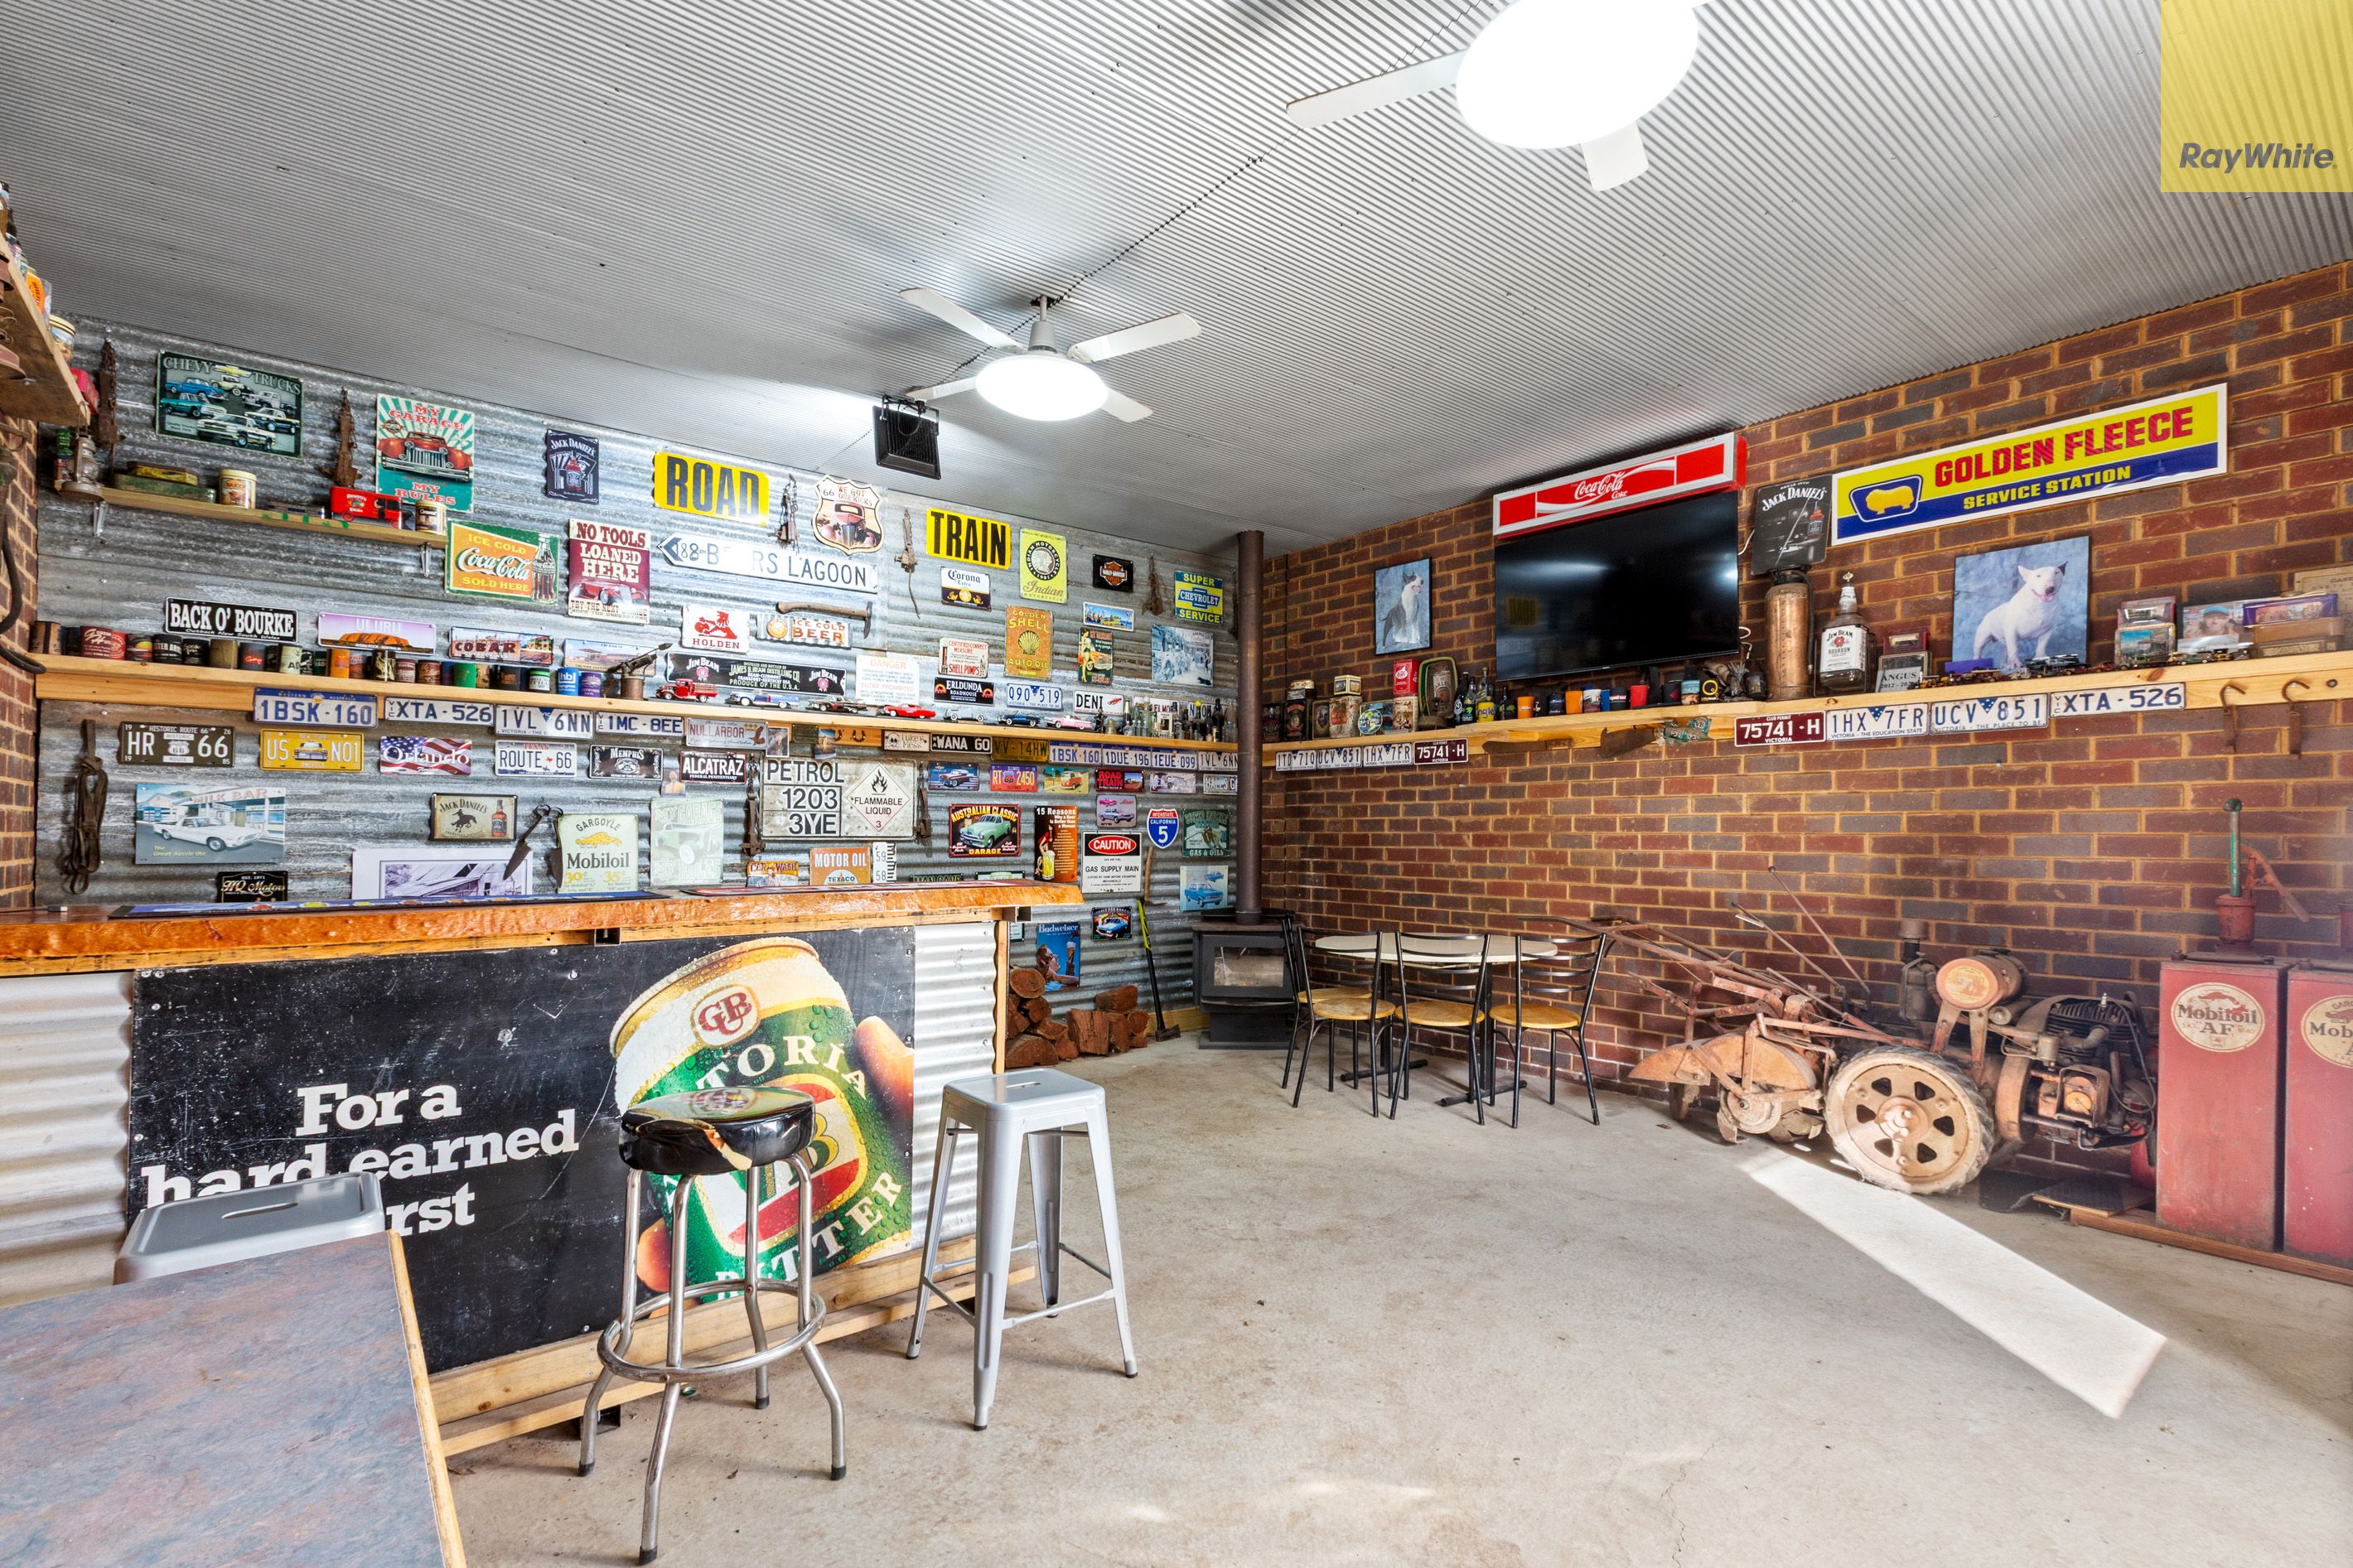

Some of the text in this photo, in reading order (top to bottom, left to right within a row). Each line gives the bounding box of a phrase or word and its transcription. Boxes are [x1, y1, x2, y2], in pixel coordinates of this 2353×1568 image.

[162, 356, 301, 395] CHEVY TRUCKS
[414, 405, 440, 417] MY
[389, 410, 464, 430] GARAGE
[550, 438, 596, 456] JACK DANIEL'S
[1935, 406, 2193, 487] GOLDEN FLEECE
[413, 482, 440, 494] MY
[667, 456, 760, 518] ROAD
[1574, 470, 1626, 500] Coca-Cola
[1964, 466, 2132, 510] SERVICE STATION
[395, 488, 456, 505] RULES
[851, 488, 866, 498] GOT
[1611, 490, 1628, 499] Coke
[1761, 487, 1827, 511] JACK DANIEL'S
[577, 522, 645, 548] NO TOOLS
[930, 511, 1006, 567] TRAIN
[468, 534, 526, 555] ICE COLD
[580, 543, 641, 565] LOANED
[457, 548, 532, 580] Coca-Cola
[582, 559, 639, 583] HERE
[707, 543, 778, 574] BRS
[788, 556, 867, 587] LAGOON
[948, 570, 981, 583] Corona
[1183, 573, 1215, 586] SUPER
[462, 577, 529, 592] SOLD HERE
[1023, 580, 1064, 597] Indian
[1180, 591, 1220, 606] CHEVROLET
[571, 600, 619, 613] TRY THE NEXT
[171, 603, 294, 637] BACK O' BOURKE
[1012, 610, 1046, 619] GOLDEN
[1180, 610, 1220, 623] SERVICE
[356, 619, 403, 632] ULURU
[816, 622, 845, 631] COLD
[1009, 618, 1049, 633] SHELL
[793, 627, 843, 641] BEER
[1827, 631, 1838, 641] JIM
[455, 642, 516, 653] COBAR
[693, 638, 740, 649] HOLDEN
[687, 657, 719, 672] JIM BEAM
[729, 664, 746, 676] JAMES
[870, 659, 906, 669] DANGER
[948, 664, 964, 674] SHELL
[1008, 658, 1048, 668] AUTO OIL
[729, 678, 758, 687] PRODUCE
[809, 669, 837, 683] JIM BEAM
[1882, 671, 1916, 682] ANGUS
[946, 680, 983, 692] ERLDUNDA
[1009, 687, 1060, 702] Q90 519
[1076, 693, 1103, 710] DENI
[1935, 697, 2041, 726] UCV 851
[503, 708, 591, 732] 1VL 6NN
[1833, 708, 1924, 733] 1HX 7FR
[689, 724, 745, 739] NULLARBOR
[901, 733, 924, 742] Luke's
[128, 731, 229, 758] HR 66
[267, 739, 289, 760] US
[937, 735, 990, 751] WANA GO
[383, 745, 470, 765] Orlando
[500, 750, 572, 769] ROUTE 66
[611, 748, 645, 760] MEMPHIS
[1318, 748, 1360, 765] UCV 851
[1365, 745, 1410, 762] 1HX 7FR
[684, 757, 744, 776] ALCATRAZ
[767, 760, 844, 783] PETROL
[1016, 770, 1035, 785] 2450
[192, 789, 267, 804] MILK BAR
[782, 788, 838, 810] 1203
[854, 797, 902, 806] FLAMMABLE
[438, 798, 489, 815] JACK DANIEL'S
[866, 806, 891, 816] LIQUID
[1047, 808, 1076, 816] Reasons
[951, 806, 1018, 823] AUSTRALIAN CLASSIC
[576, 818, 621, 832] GARGOYLE
[789, 813, 836, 835] 3YE
[1158, 826, 1168, 843] 5
[1094, 840, 1131, 851] CAUTION
[567, 852, 629, 869] Mobiloil
[814, 852, 867, 868] MOTOR OIL
[876, 852, 886, 861] 59
[876, 871, 886, 880] 58
[1038, 924, 1079, 934] Budweiser
[2177, 1004, 2257, 1024] Mobiloil
[2200, 1022, 2235, 1035] AF
[296, 1083, 462, 1137] For a
[348, 1109, 580, 1183] earned
[386, 1182, 476, 1236] rst
